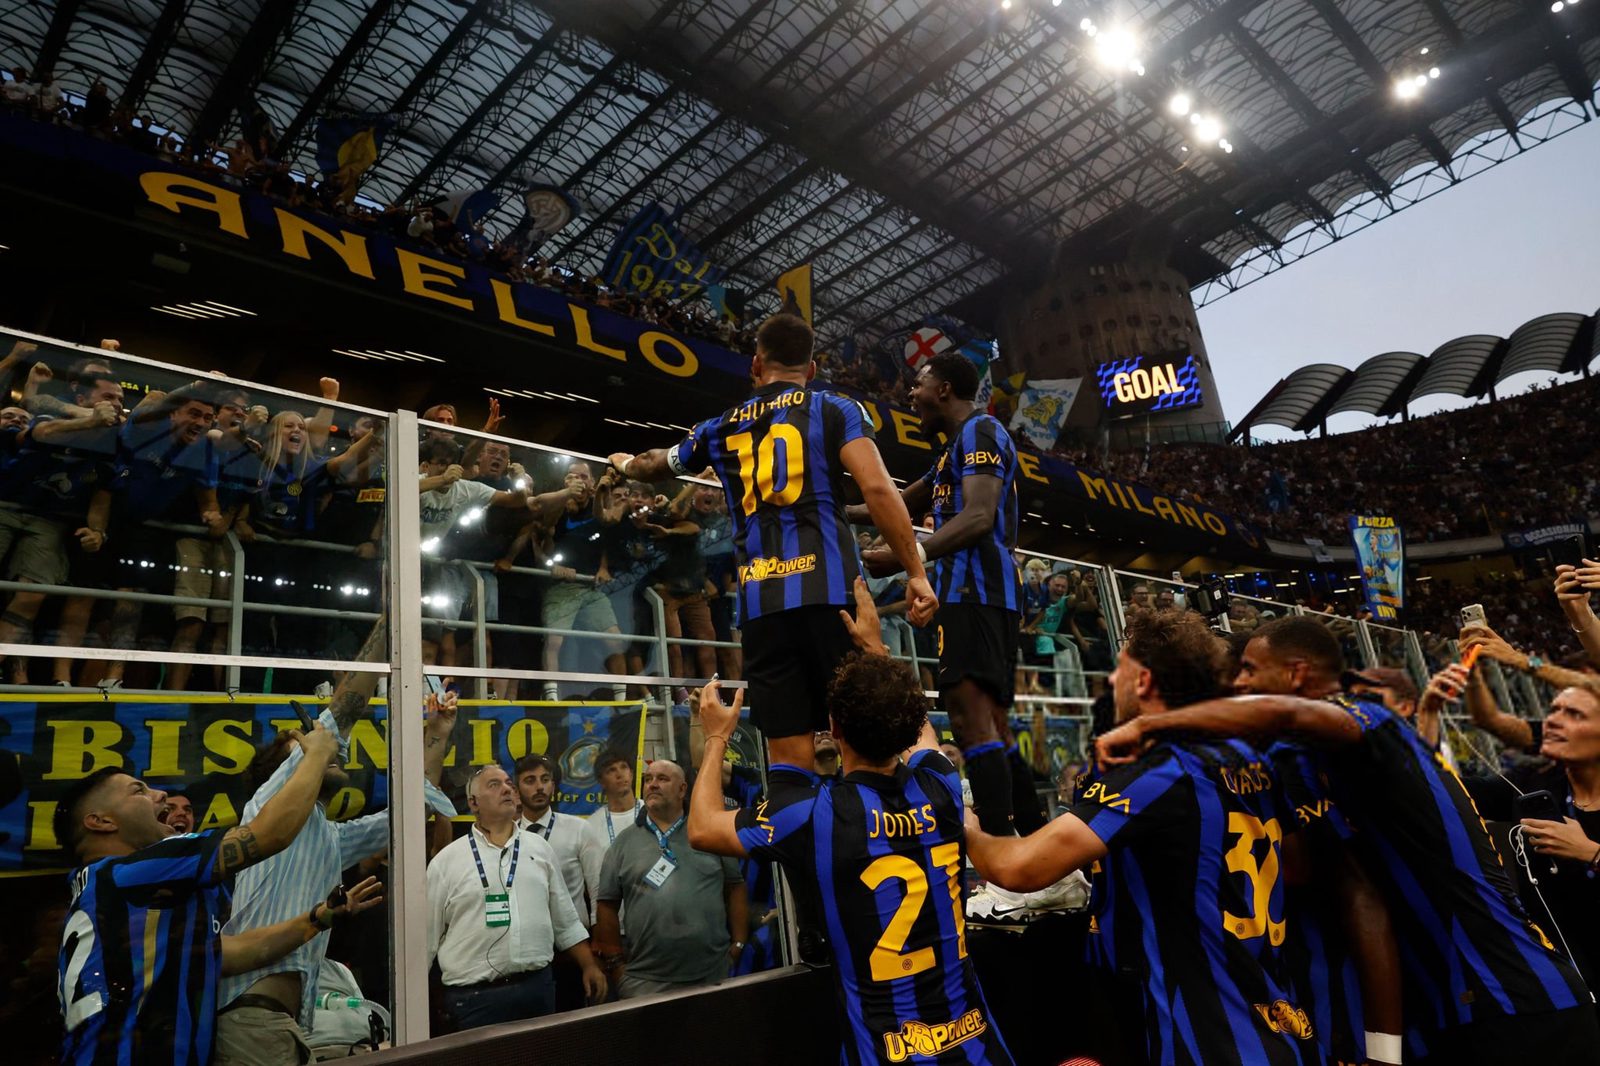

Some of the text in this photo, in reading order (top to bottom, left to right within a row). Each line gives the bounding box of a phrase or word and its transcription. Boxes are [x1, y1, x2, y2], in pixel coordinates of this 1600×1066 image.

[138, 170, 699, 379] ANELLO
[1077, 469, 1228, 537] MILANO
[1113, 363, 1185, 403] GOAL
[725, 422, 805, 517] 10
[41, 718, 549, 782] BISNIO
[869, 804, 937, 839] JONES
[859, 842, 969, 983] 21
[57, 910, 104, 1033] 2
